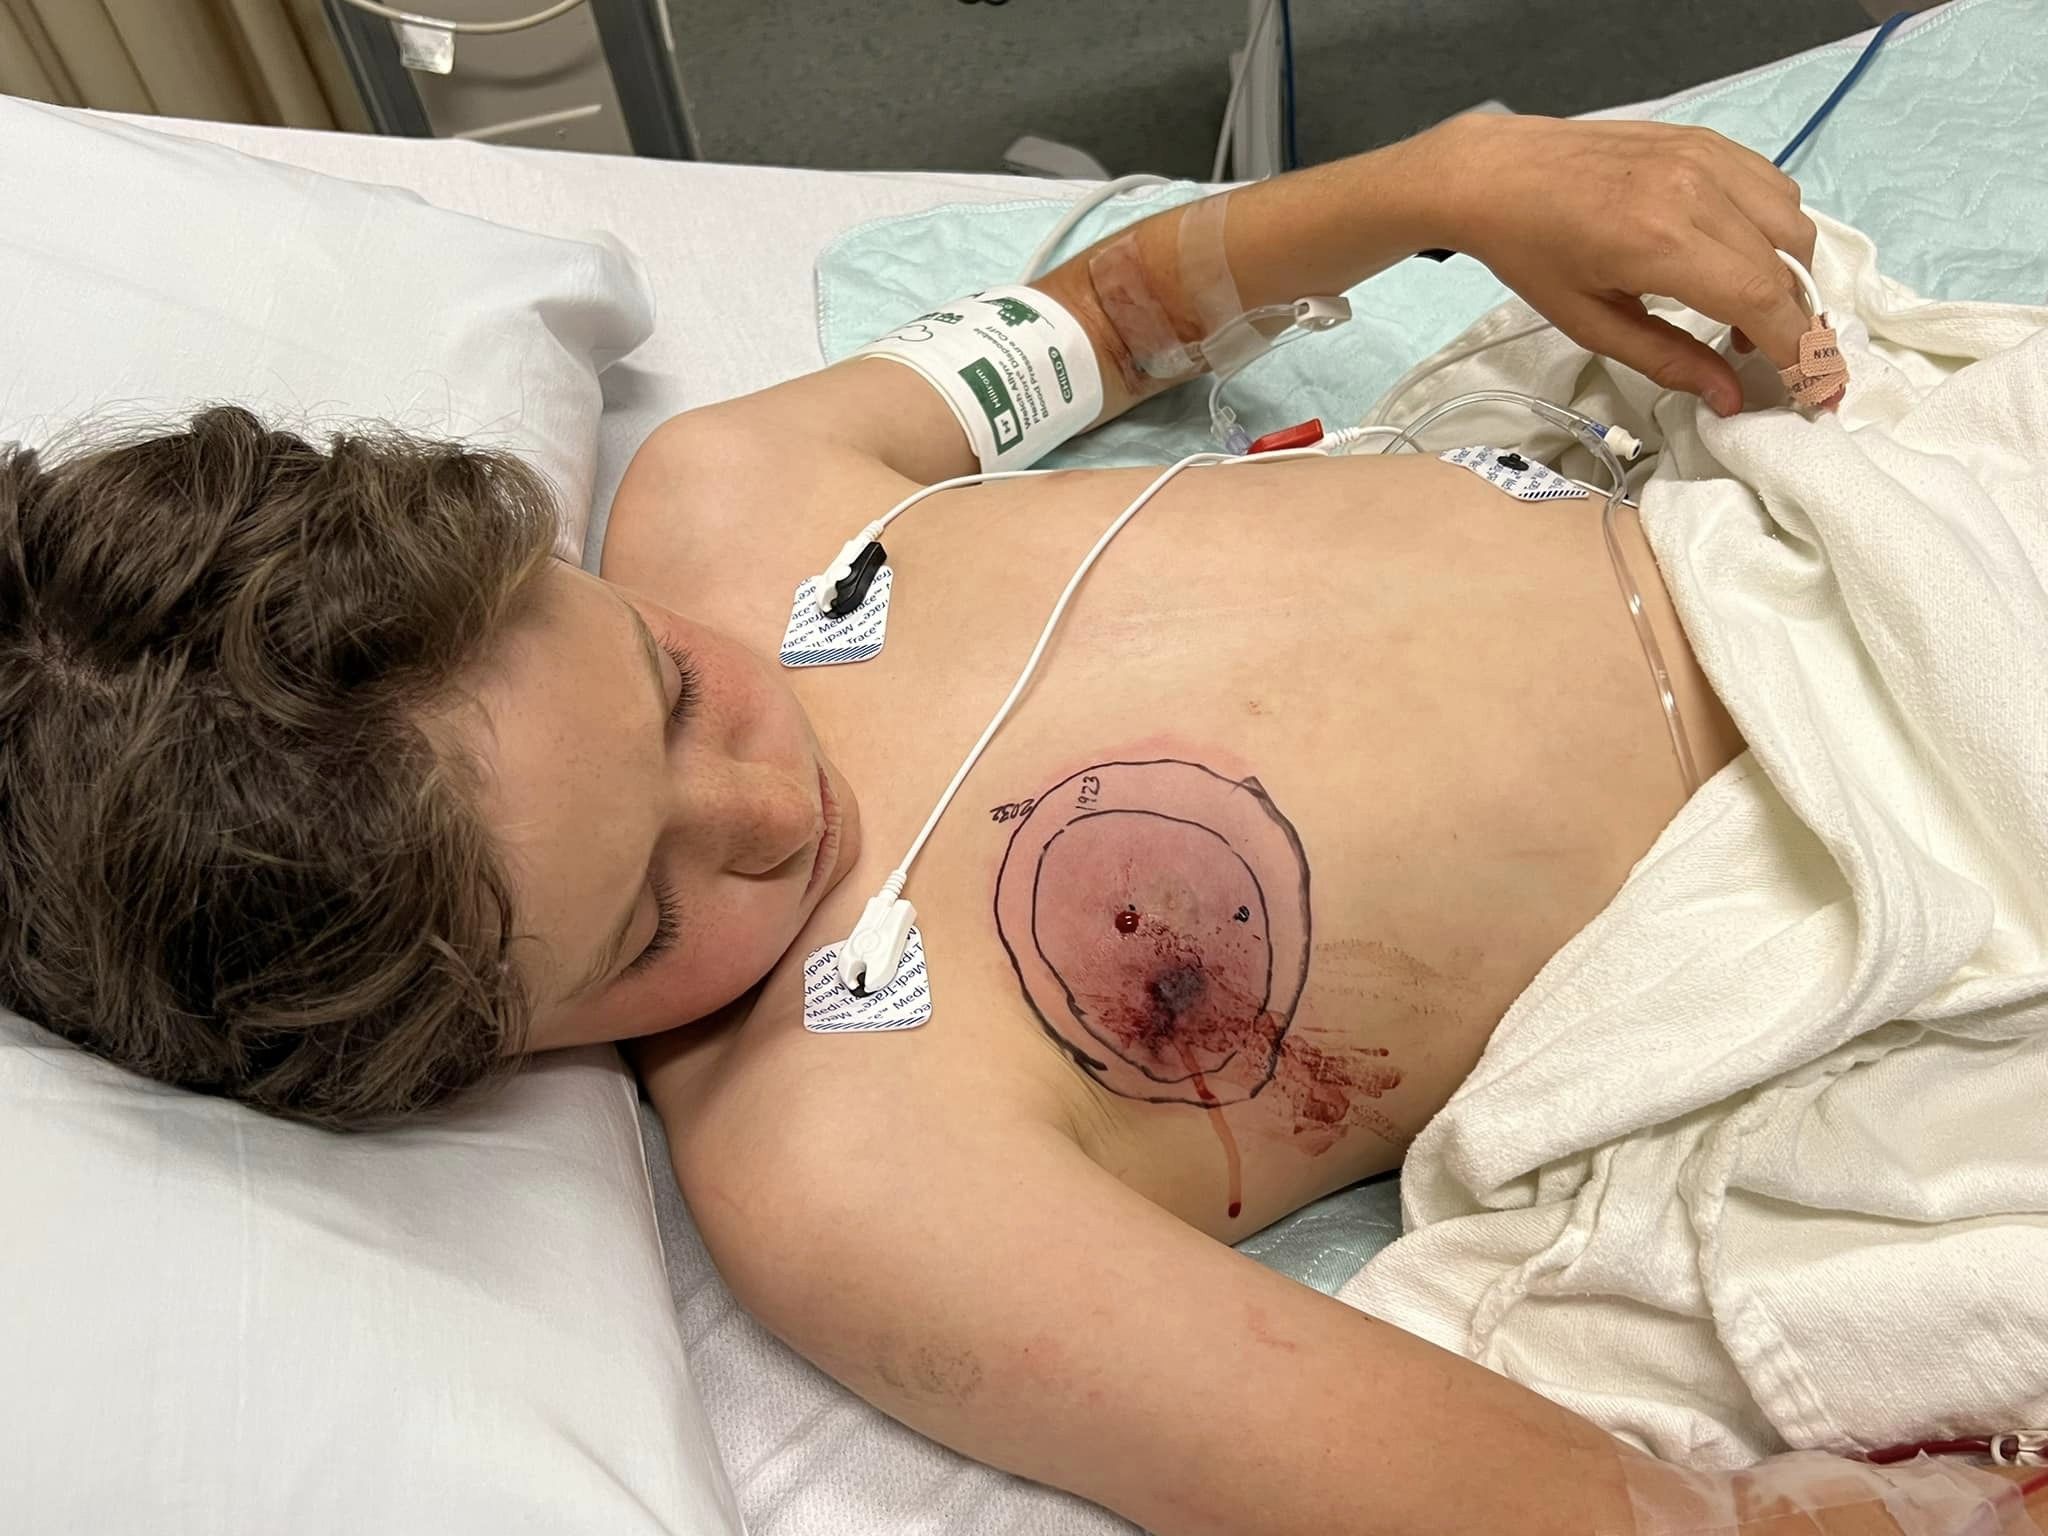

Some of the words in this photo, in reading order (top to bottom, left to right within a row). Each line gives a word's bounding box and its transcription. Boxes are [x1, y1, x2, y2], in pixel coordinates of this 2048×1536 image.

[973, 328, 1020, 369] Disposable
[985, 326, 1009, 341] Cuff
[1009, 341, 1038, 385] Pressure
[1055, 361, 1071, 399] CHILD
[975, 368, 1001, 409] Hillrom
[1033, 385, 1049, 419] Blood
[1016, 393, 1031, 430] Welch
[1075, 776, 1100, 811] 1923
